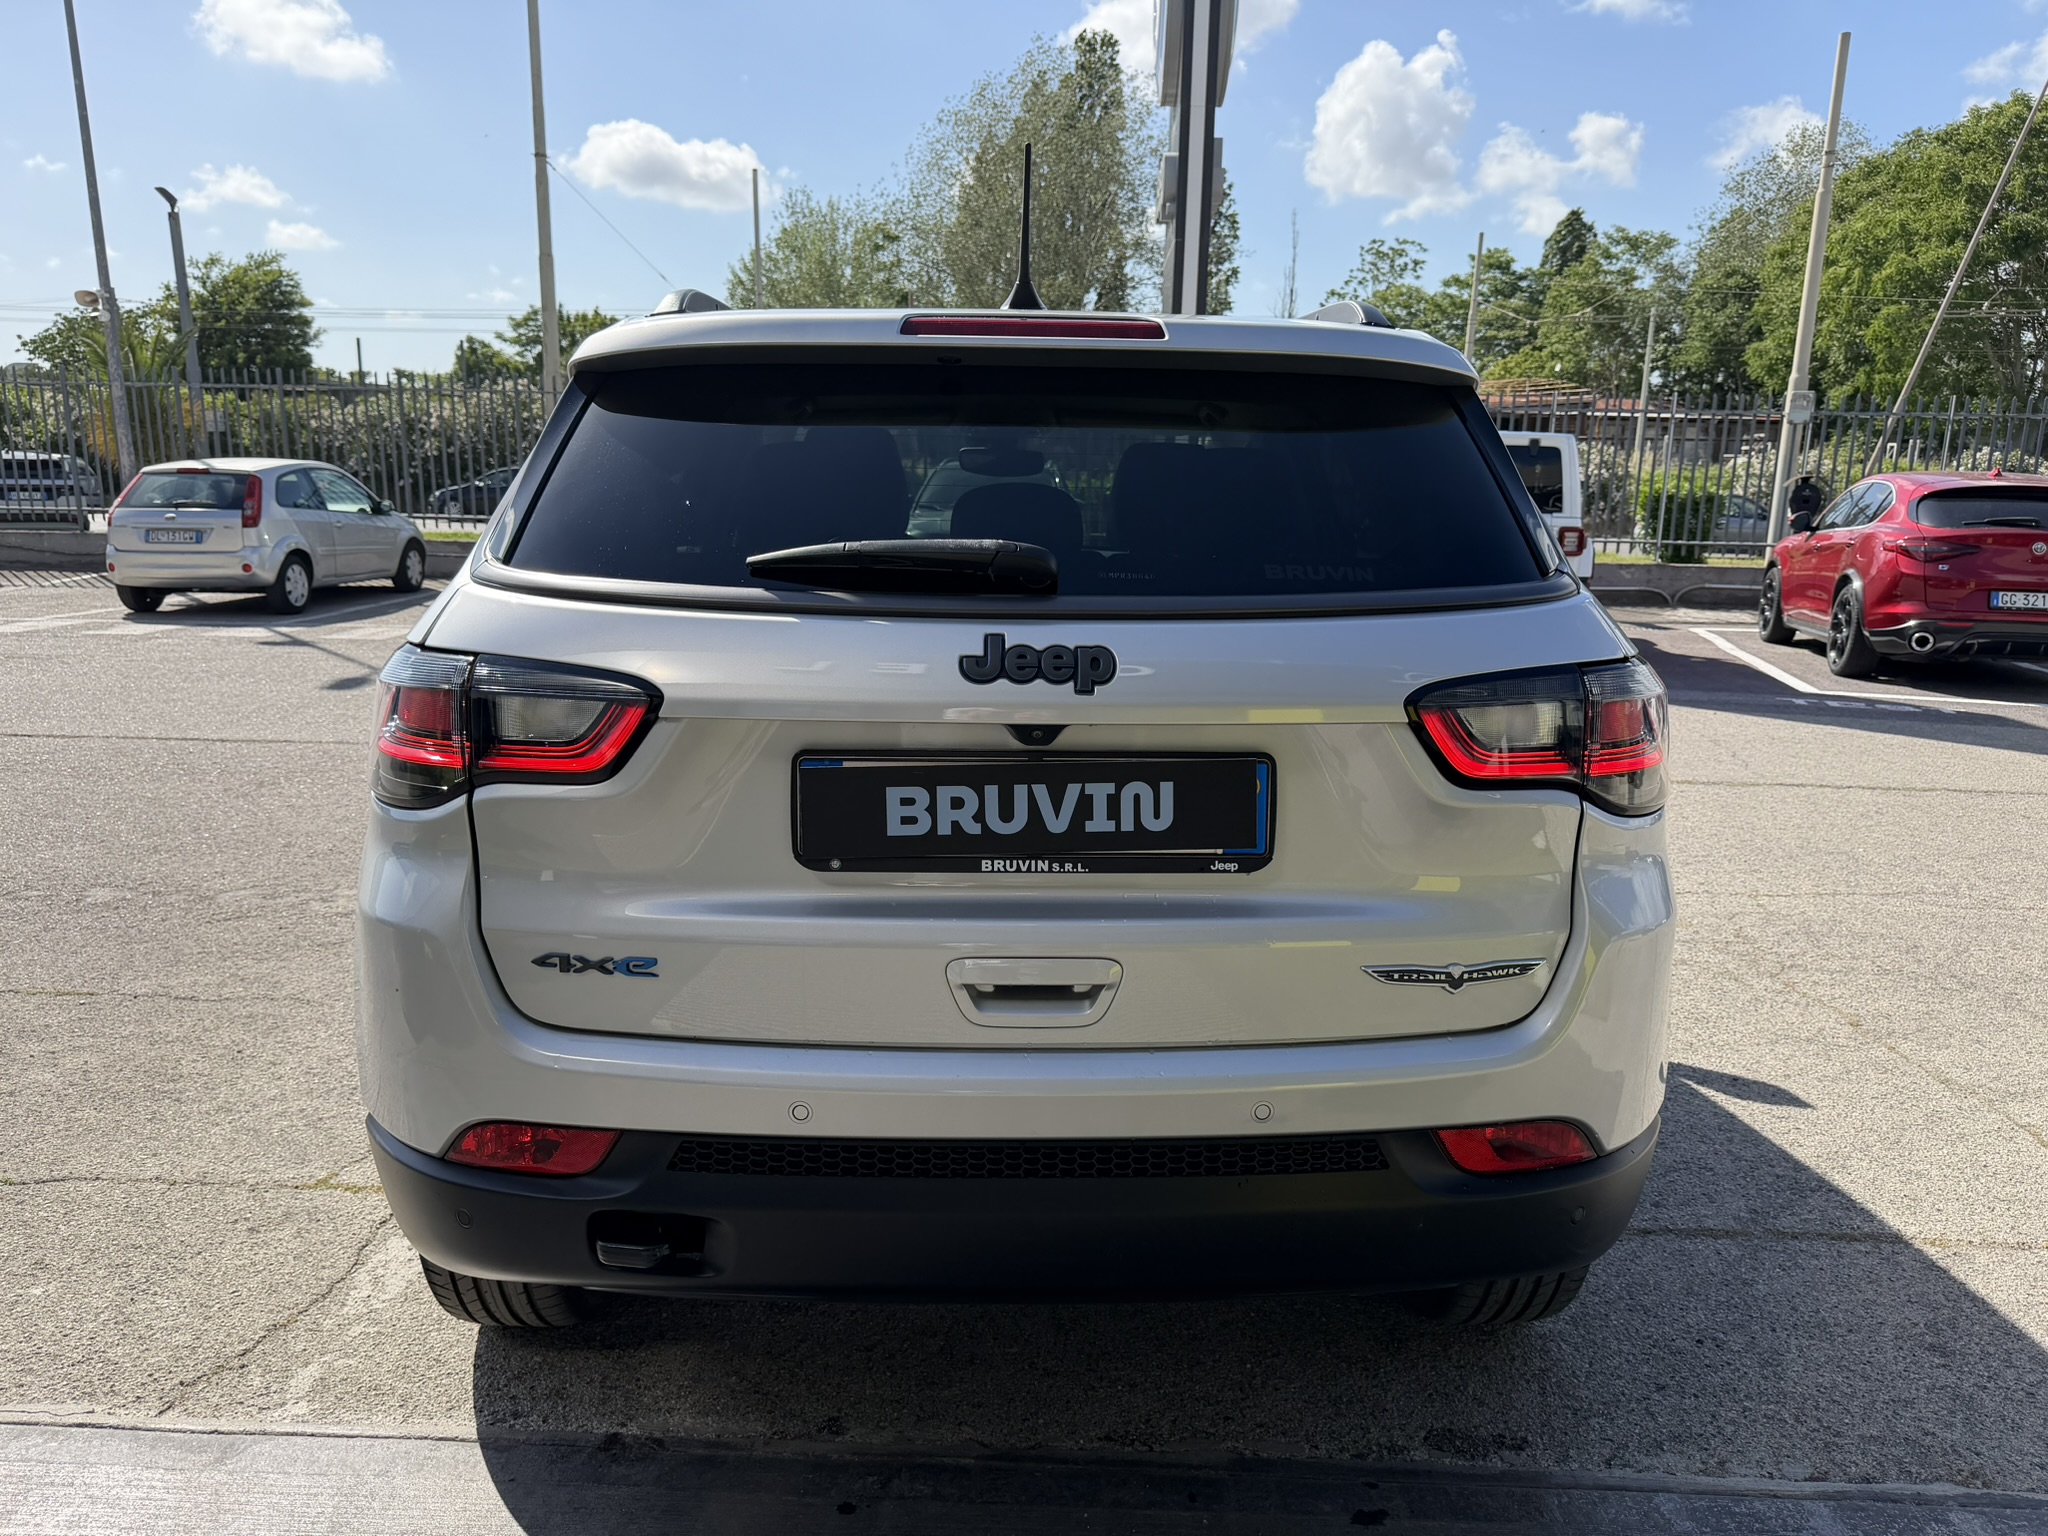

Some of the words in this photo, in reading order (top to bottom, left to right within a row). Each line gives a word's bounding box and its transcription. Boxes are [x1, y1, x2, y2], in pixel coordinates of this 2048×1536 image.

[1264, 564, 1376, 582] BRUVIN
[959, 633, 1118, 696] Jeep
[885, 780, 1174, 837] BRUVIN
[981, 859, 1049, 872] BRUVIN
[1051, 862, 1089, 872] S.R.L.
[1210, 860, 1239, 873] Jeep
